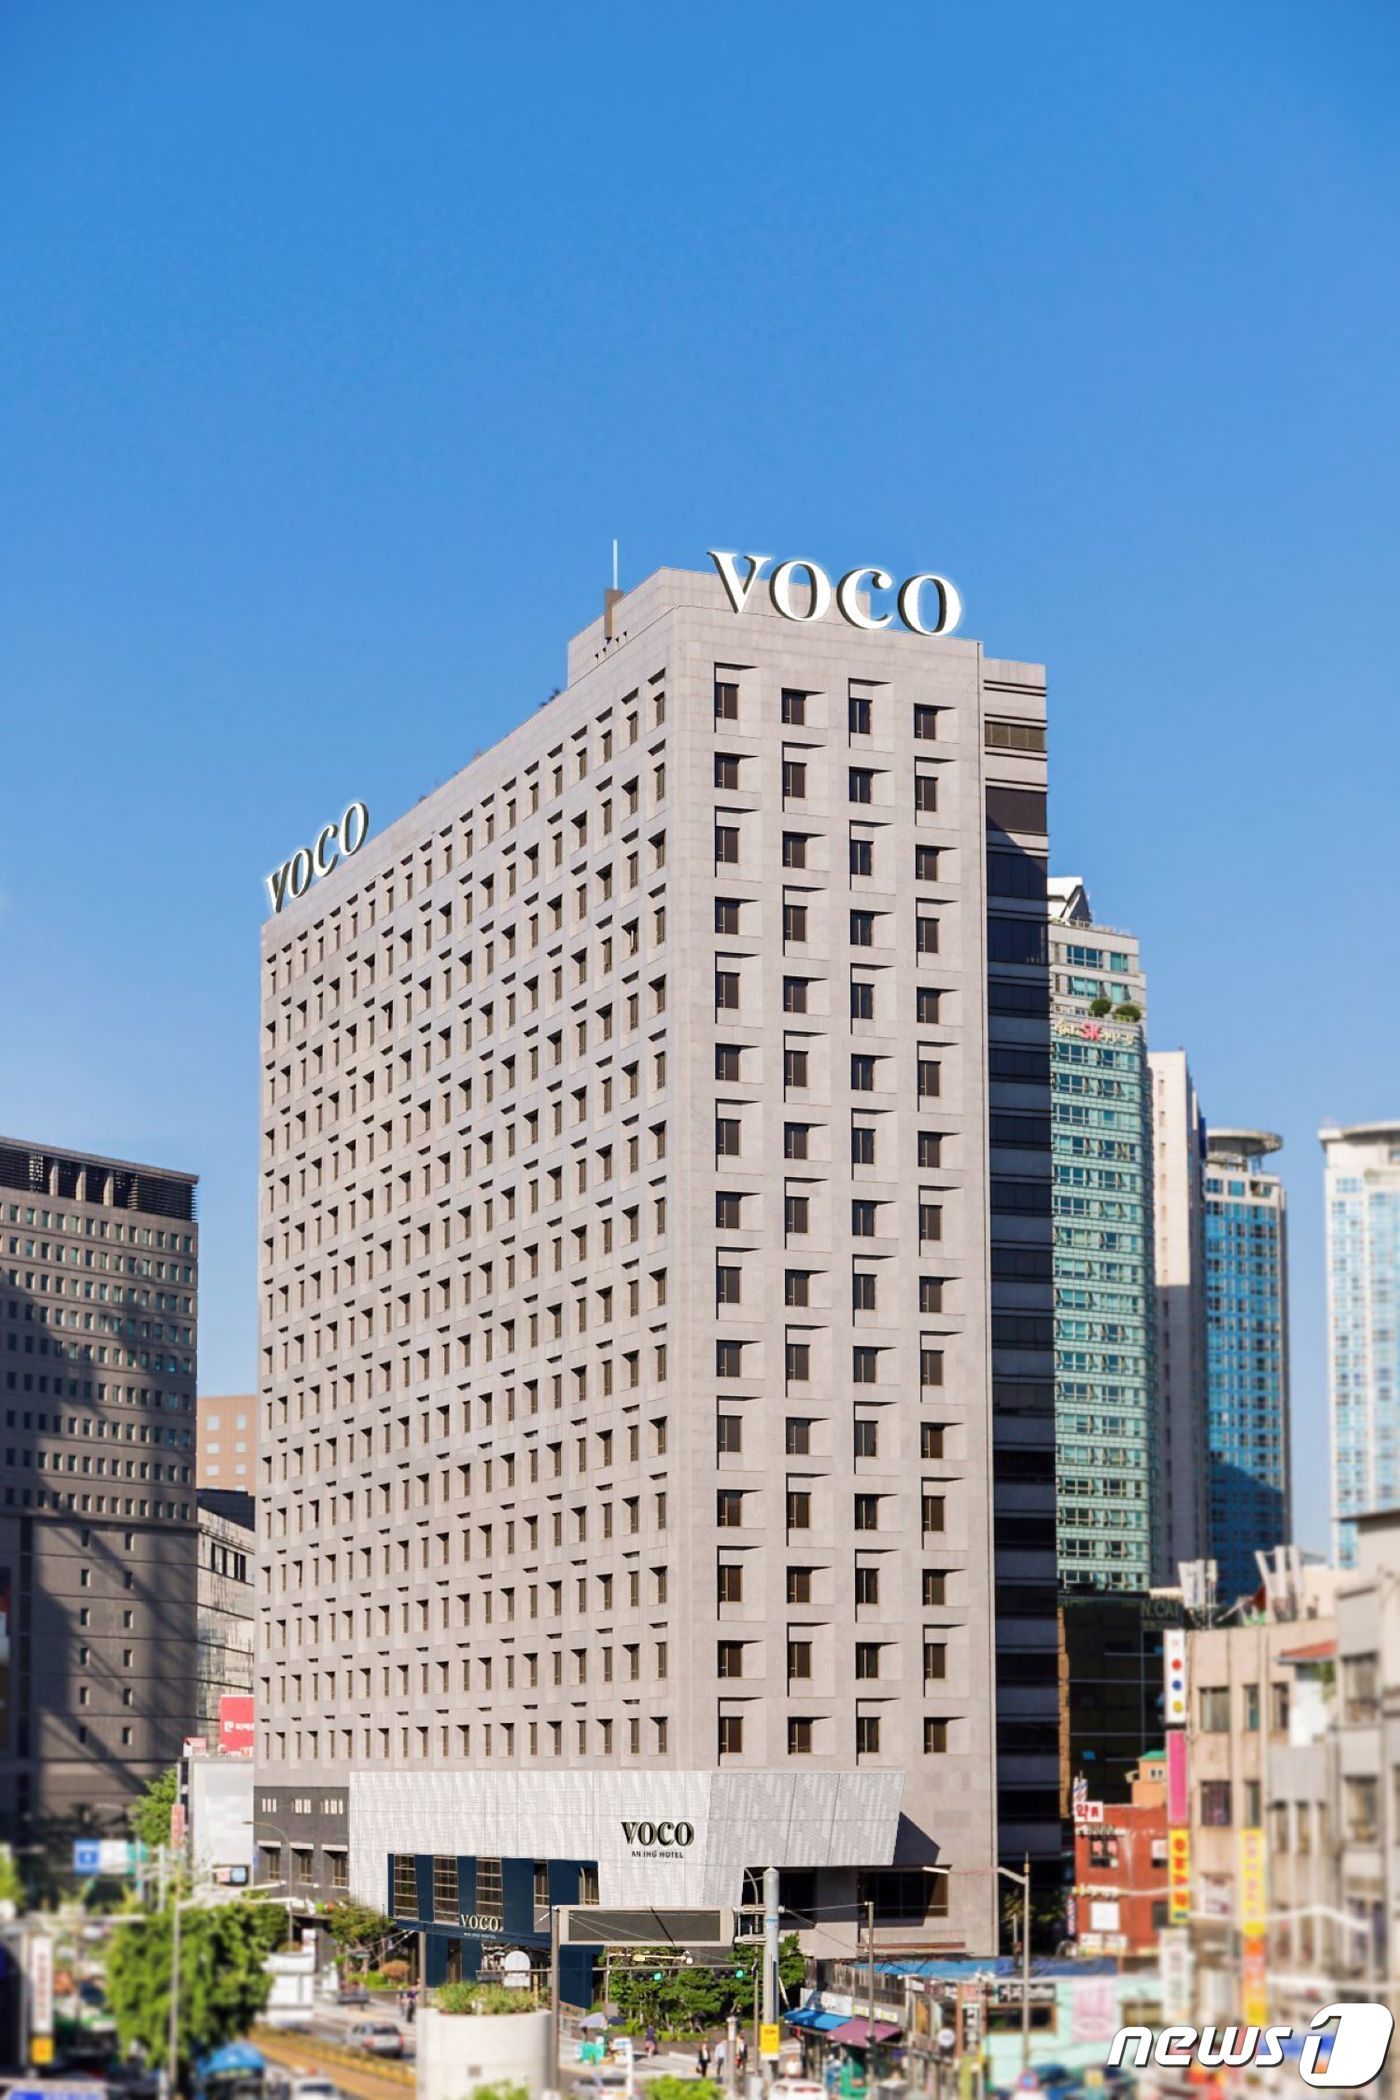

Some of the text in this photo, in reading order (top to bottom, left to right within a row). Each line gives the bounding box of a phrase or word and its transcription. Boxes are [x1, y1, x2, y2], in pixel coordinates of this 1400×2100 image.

[706, 551, 962, 637] VOCO
[265, 802, 370, 914] VOCO
[620, 1821, 695, 1847] VOCO
[659, 1851, 684, 1859] HOTEL
[460, 1914, 499, 1933] VOCO
